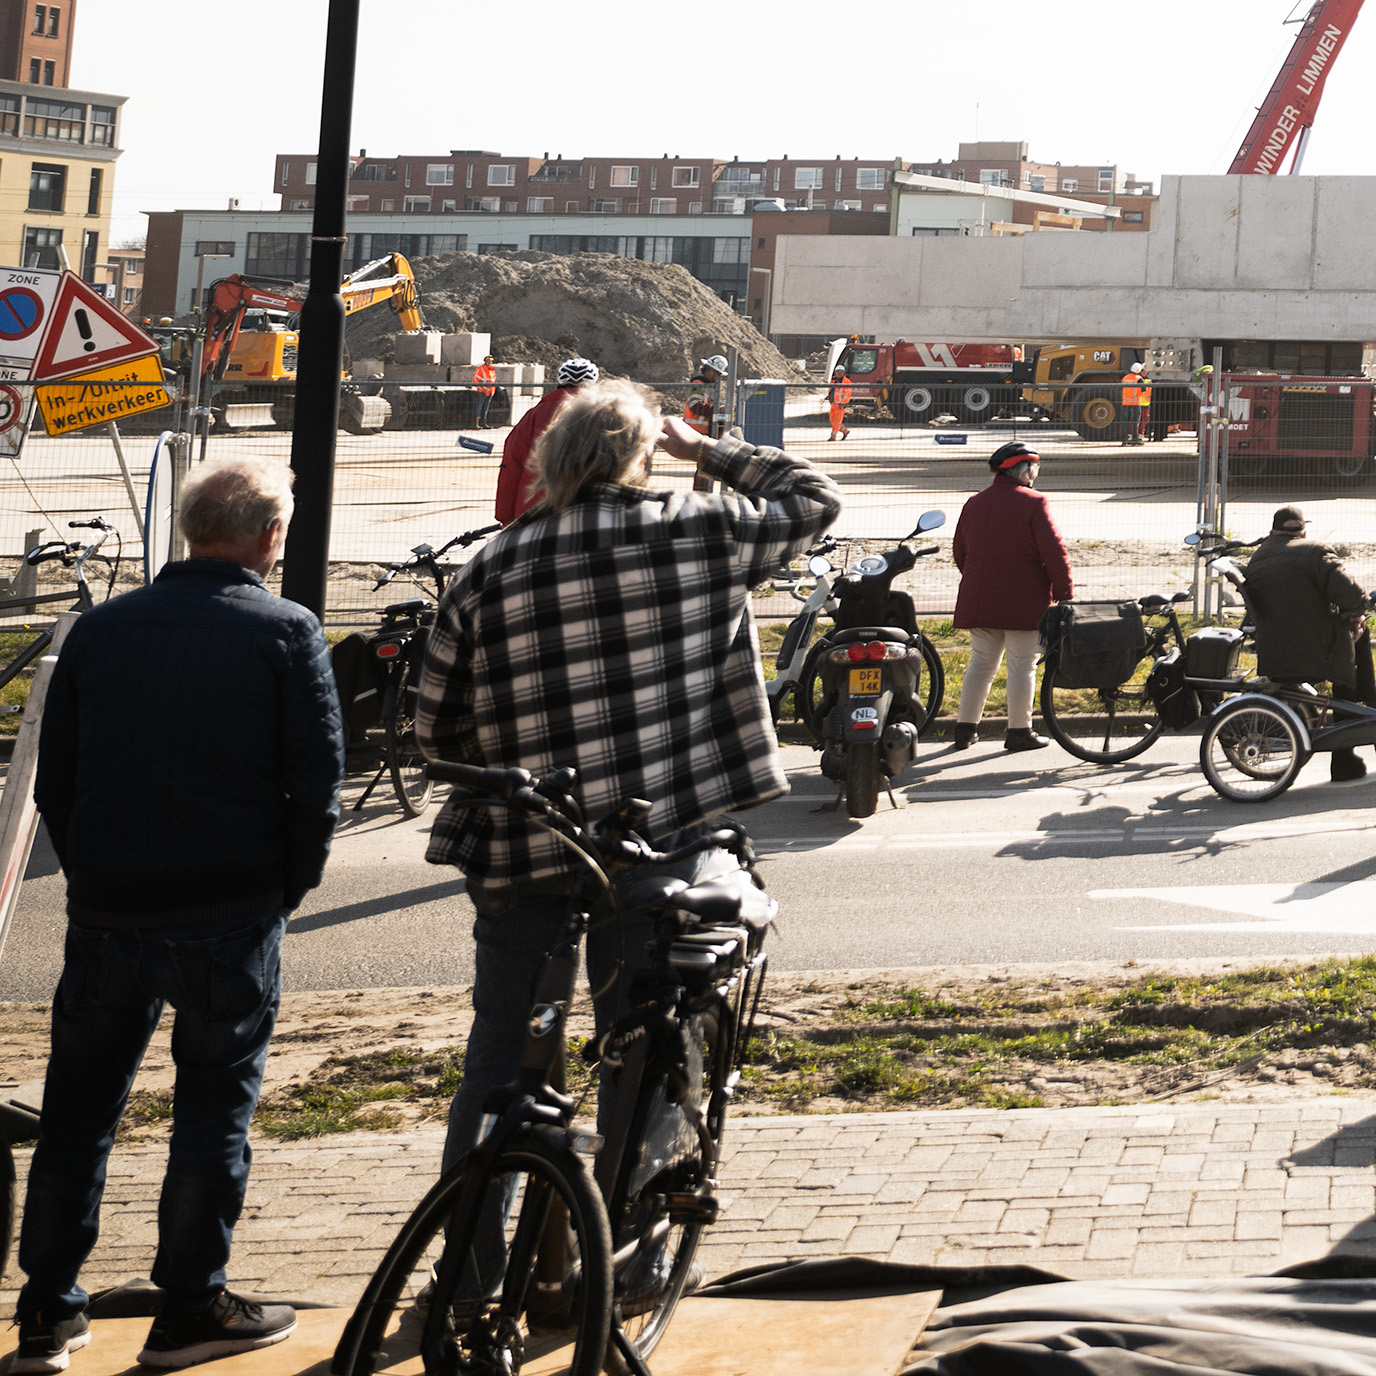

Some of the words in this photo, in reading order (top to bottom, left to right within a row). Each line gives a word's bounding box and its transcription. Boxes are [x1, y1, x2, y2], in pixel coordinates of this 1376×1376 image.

[1253, 104, 1301, 175] WINDER
[1296, 23, 1343, 96] LIMMEN
[8, 273, 41, 286] ZONE
[108, 289, 113, 297] 2
[1093, 350, 1112, 362] CAT
[0, 371, 18, 380] NE
[53, 386, 164, 429] werkverkeer
[860, 670, 880, 680] DFX
[861, 681, 879, 691] 14K
[855, 710, 872, 719] NL
